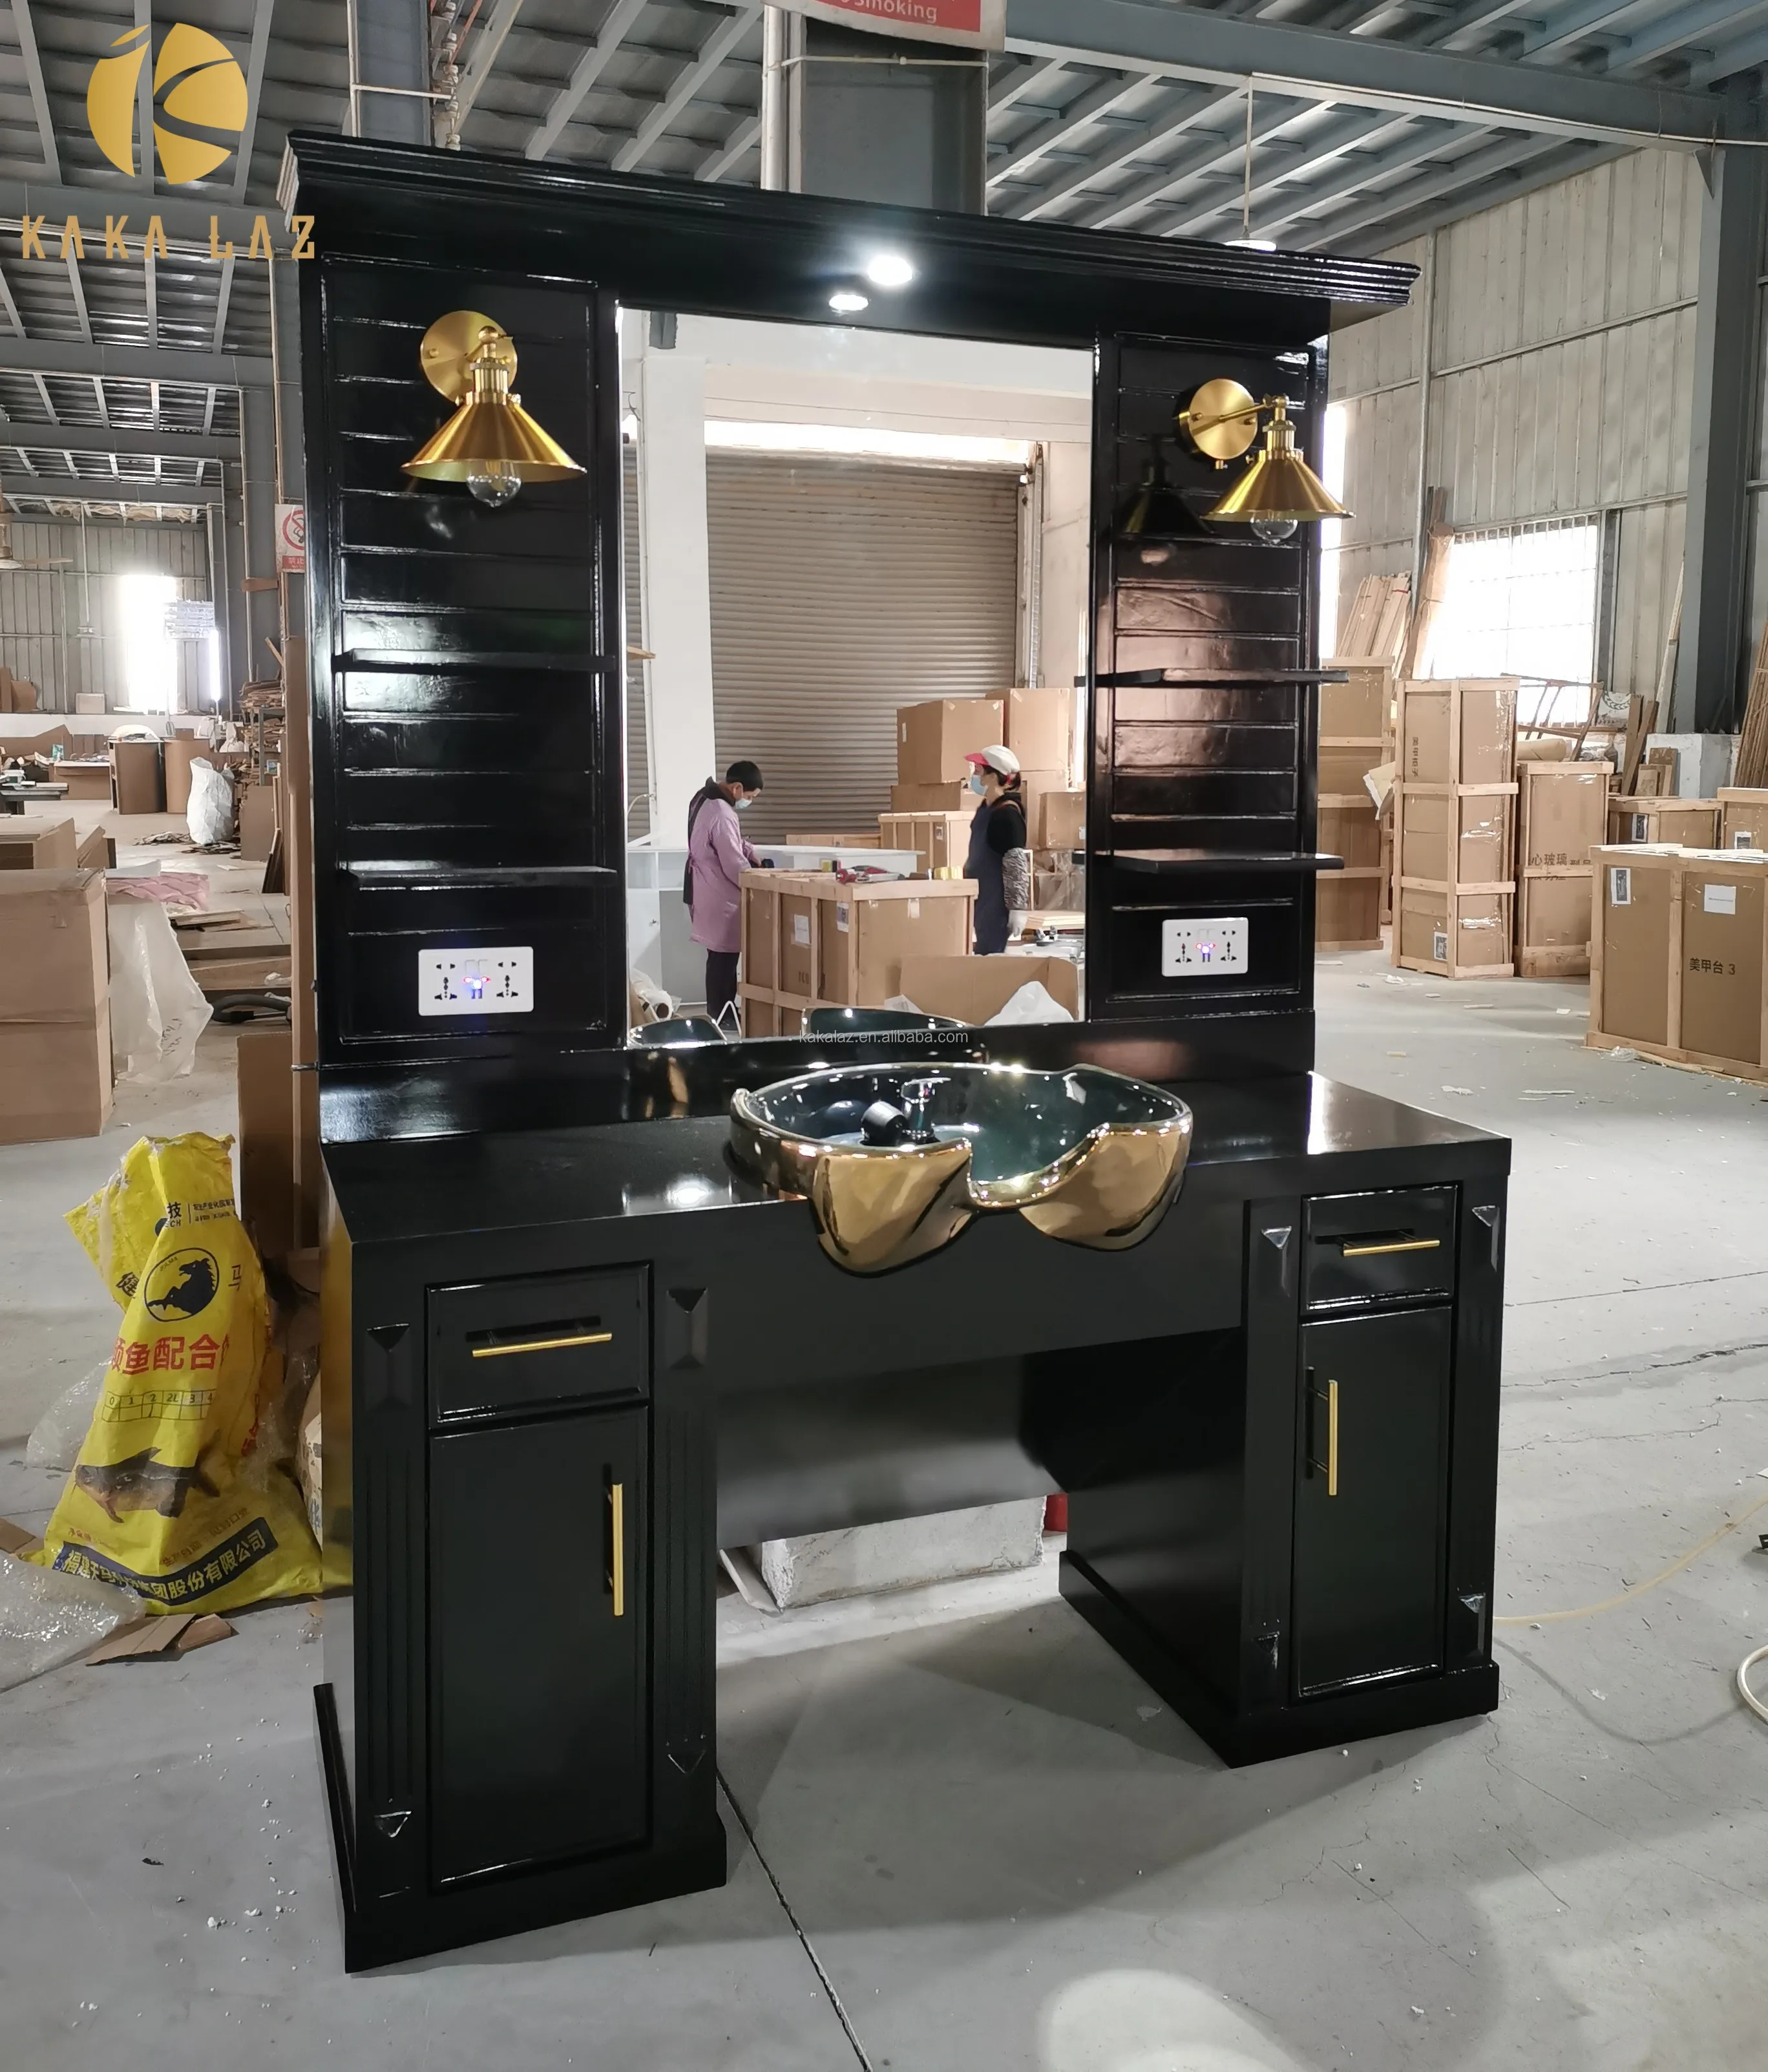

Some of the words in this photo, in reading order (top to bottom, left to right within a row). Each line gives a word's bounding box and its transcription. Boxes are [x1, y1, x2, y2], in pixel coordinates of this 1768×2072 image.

[1689, 957, 1724, 975] 美甲台
[1728, 963, 1736, 975] 3
[167, 1201, 182, 1218] 技
